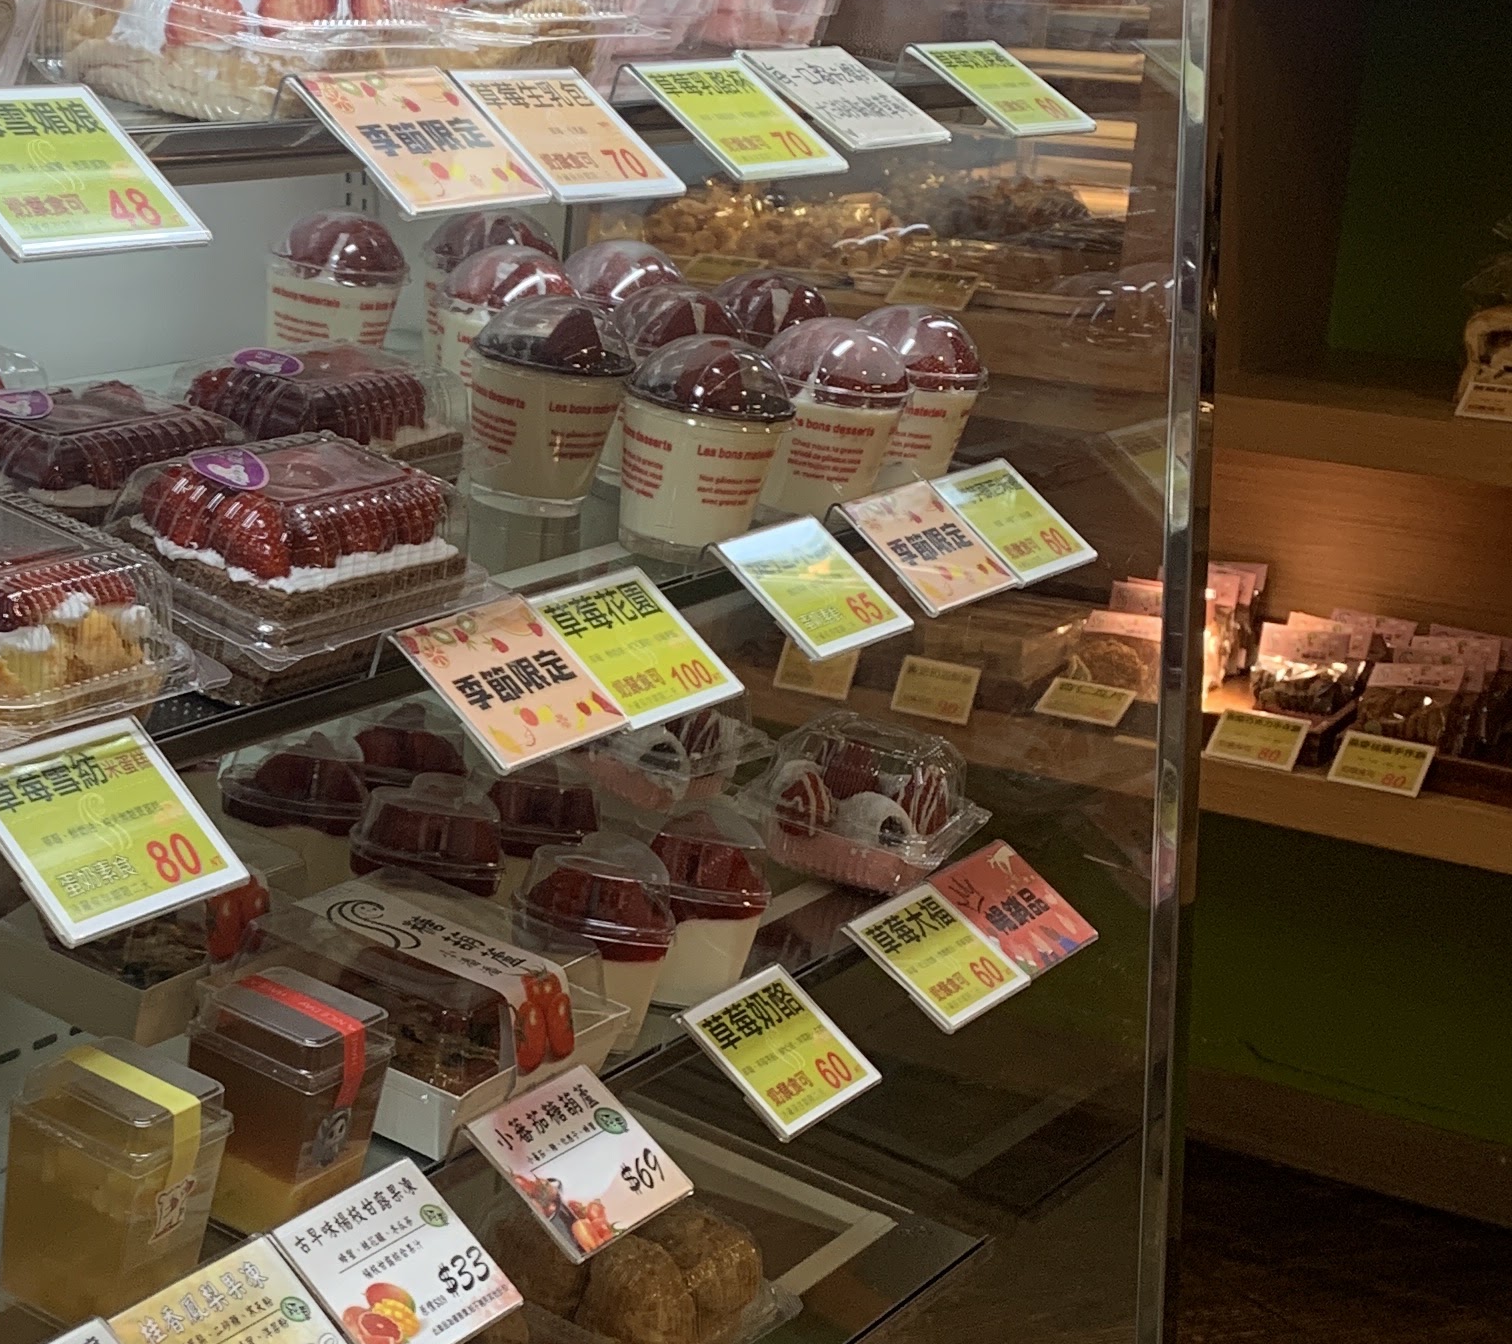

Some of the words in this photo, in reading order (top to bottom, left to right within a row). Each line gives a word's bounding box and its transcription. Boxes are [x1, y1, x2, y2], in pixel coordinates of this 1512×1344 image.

[467, 79, 596, 109] 草莓生乳包
[647, 69, 759, 98] 草莓乳酪杯
[355, 116, 496, 157] 季節限定
[769, 130, 814, 158] 70
[600, 148, 649, 179] 70
[91, 187, 168, 226] 48
[697, 444, 717, 457] Les
[886, 522, 975, 567] 季節限定
[1038, 527, 1073, 556] 60
[543, 580, 665, 640] 草莓花園
[846, 592, 884, 625] 65
[451, 647, 578, 711] 季節限定
[669, 658, 714, 694] 100
[55, 853, 139, 898] 蛋奶素食
[139, 831, 209, 885] 80
[861, 896, 958, 957] 草莓大福
[980, 884, 1051, 936] 暢銷品
[964, 955, 1009, 989] 60
[699, 979, 805, 1054] 草莓奶酪
[810, 1049, 858, 1091] 60
[619, 1146, 666, 1195] $69
[290, 1173, 421, 1257] 古早味楊枝甘露果凍
[430, 1244, 499, 1301] $33
